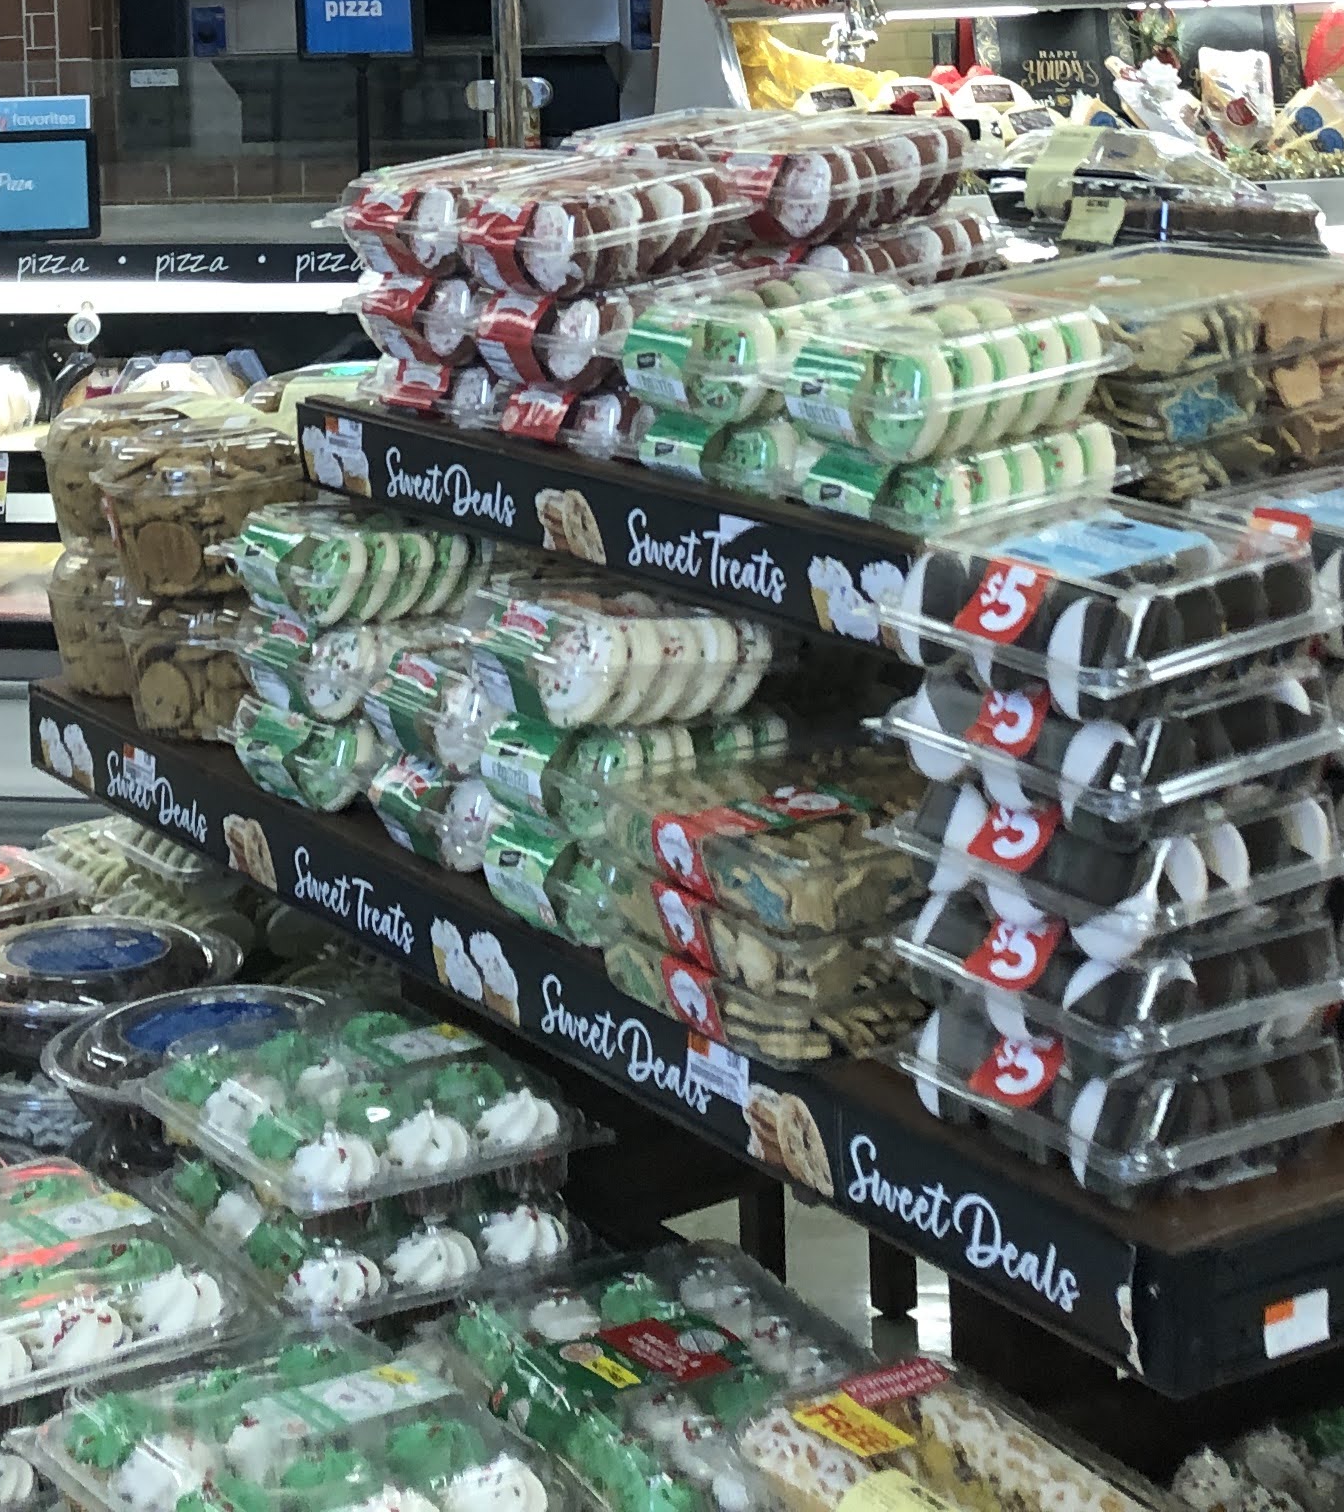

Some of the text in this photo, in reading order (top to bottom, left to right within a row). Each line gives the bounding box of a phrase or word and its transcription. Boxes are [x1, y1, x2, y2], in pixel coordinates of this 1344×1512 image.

[12, 111, 77, 127] favorites
[17, 254, 90, 283] pizza
[155, 253, 230, 283] pizza
[295, 252, 367, 282] pizza
[384, 446, 517, 528] Sweet Deals
[627, 507, 789, 604] Sweet Treats
[978, 564, 1038, 633] $5
[106, 750, 209, 843] Sweet Deals
[293, 845, 416, 955] Sweet Treats
[540, 972, 713, 1116] Sweet Deals
[846, 1135, 1081, 1315] Sweet Deals
